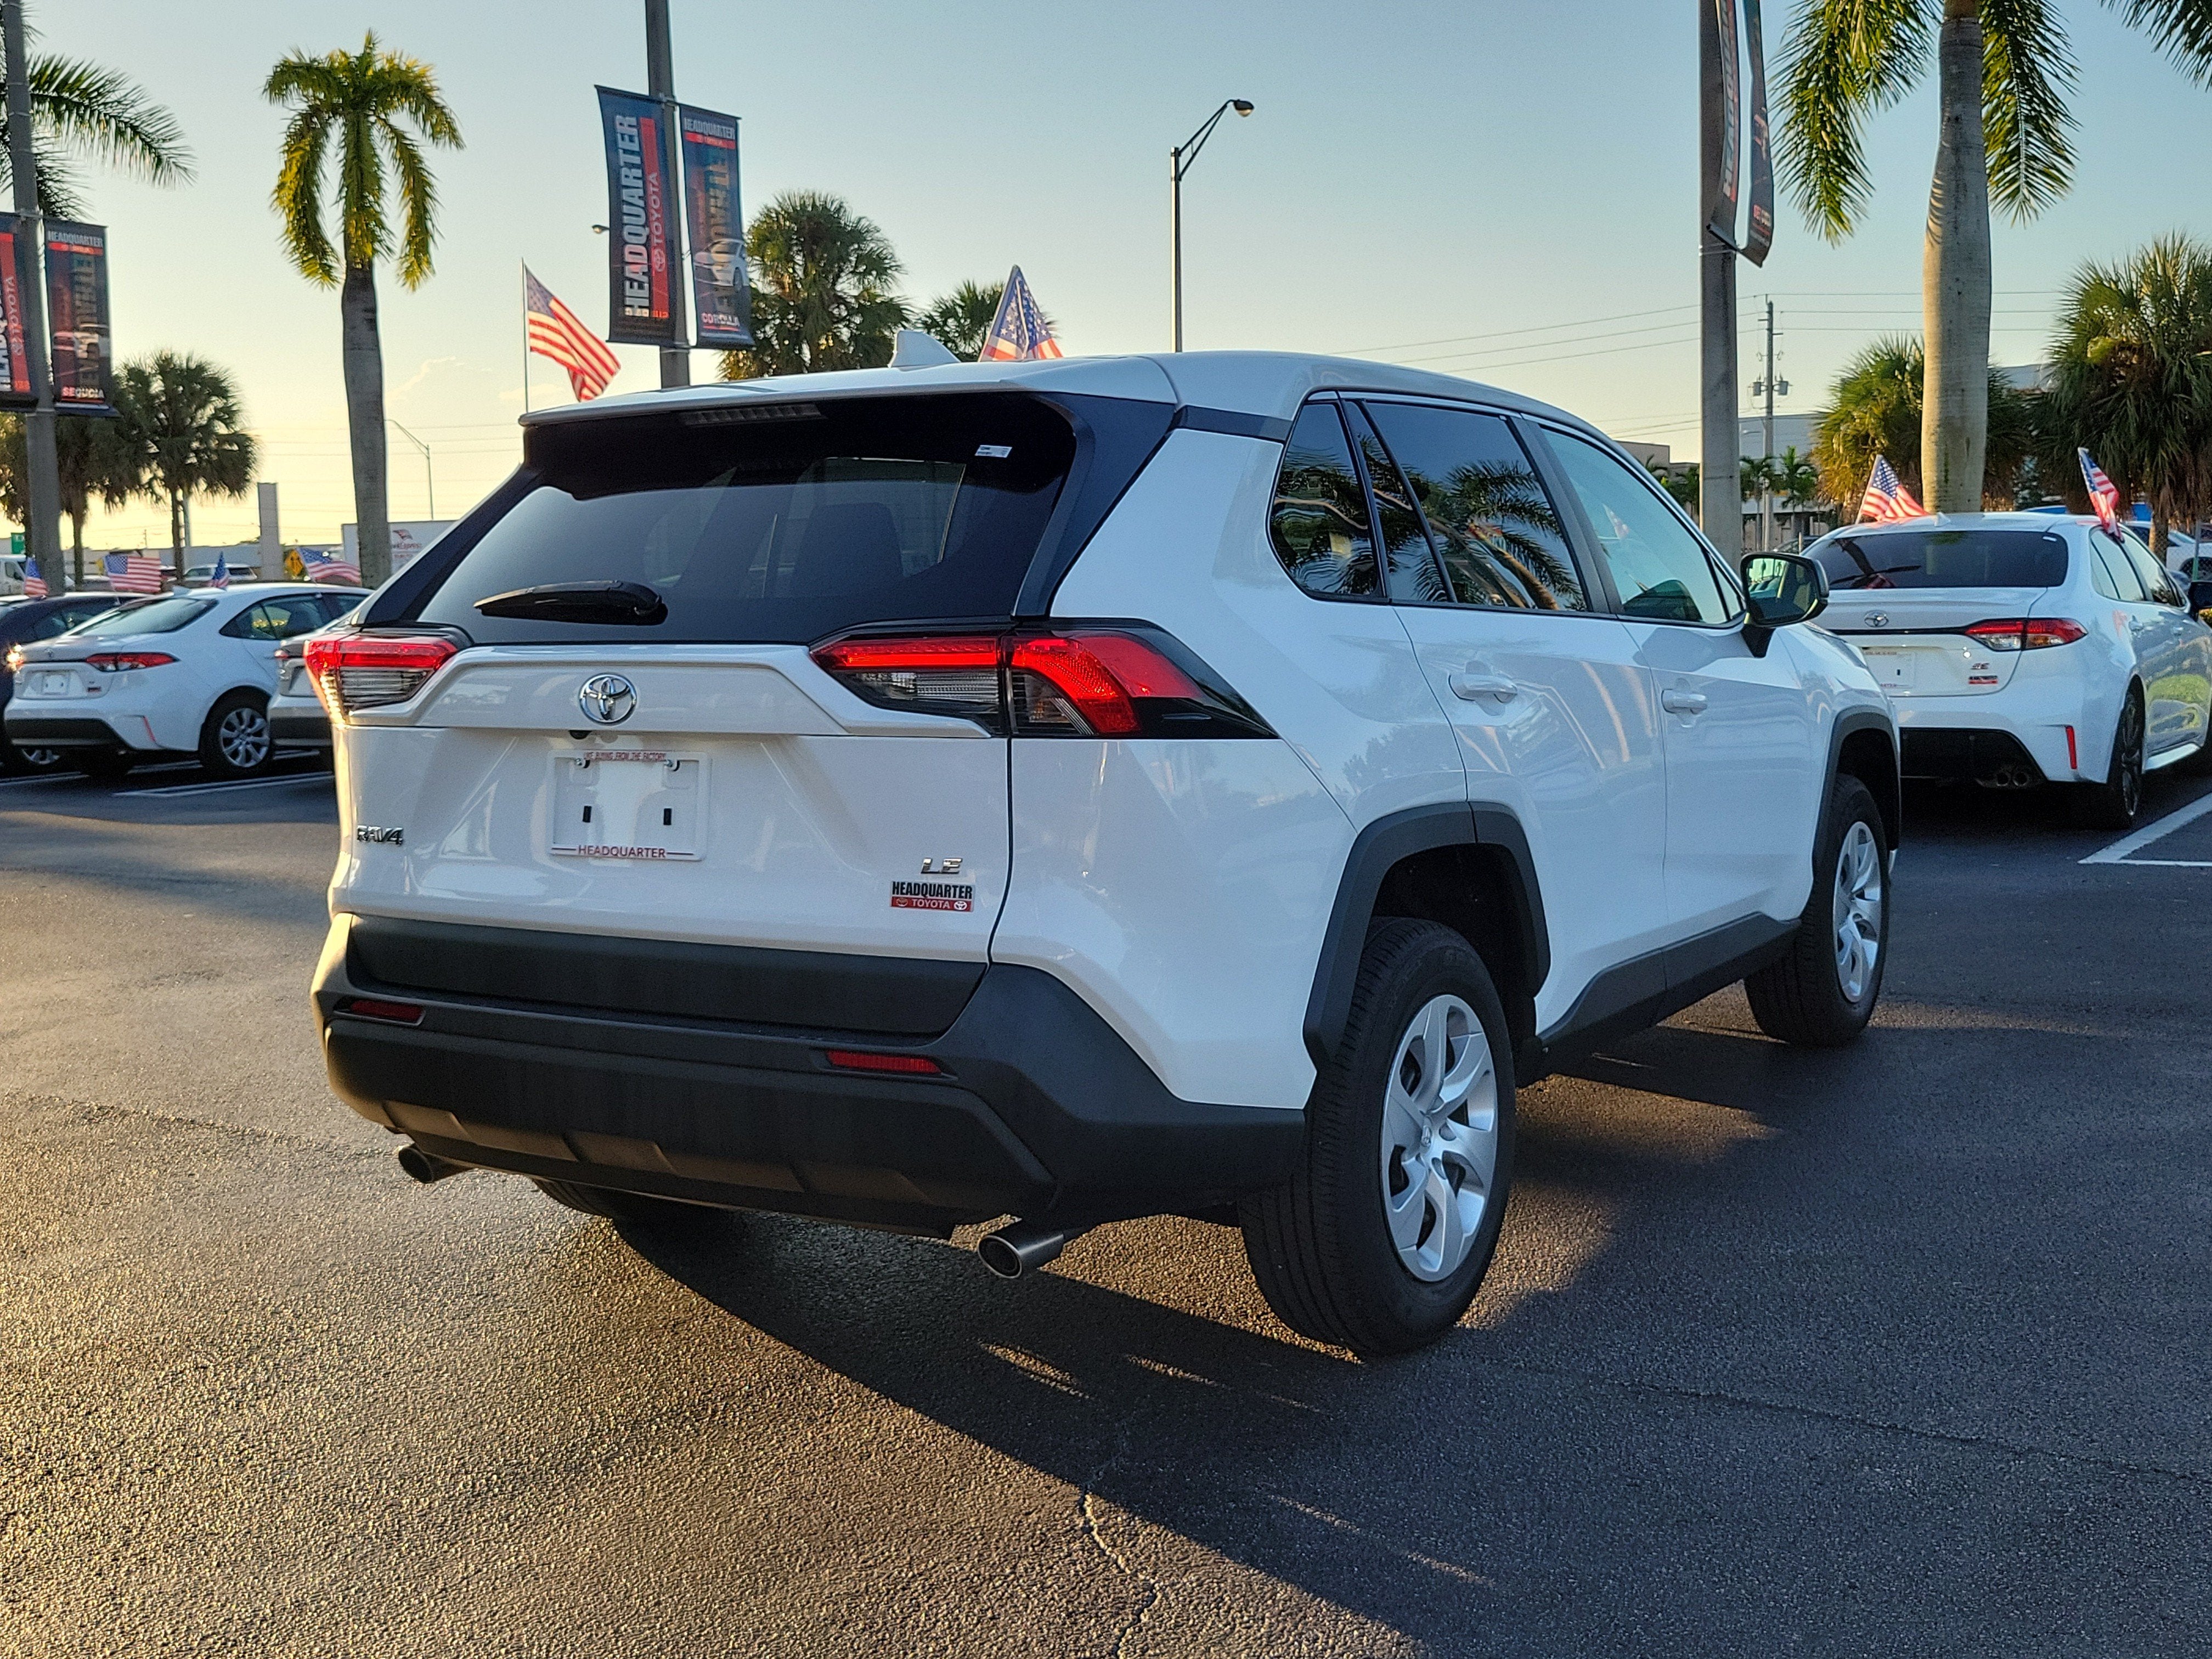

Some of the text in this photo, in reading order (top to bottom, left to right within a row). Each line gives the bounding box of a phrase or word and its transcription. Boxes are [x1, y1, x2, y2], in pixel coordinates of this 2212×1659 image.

[684, 117, 736, 140] HEADQUARTER
[616, 114, 650, 318] HEADQUARTER
[648, 172, 665, 245] TOYOTA
[48, 230, 103, 247] HEADQUARTER
[5, 276, 21, 334] TOYOTA
[701, 312, 740, 326] COROLLA
[62, 386, 105, 398] SEQUOIA
[357, 825, 404, 845] RAV4
[578, 845, 666, 858] HEADQUARTER
[920, 857, 963, 874] LE
[892, 881, 973, 899] HEADQUARTER
[911, 899, 950, 909] TOYOTA
